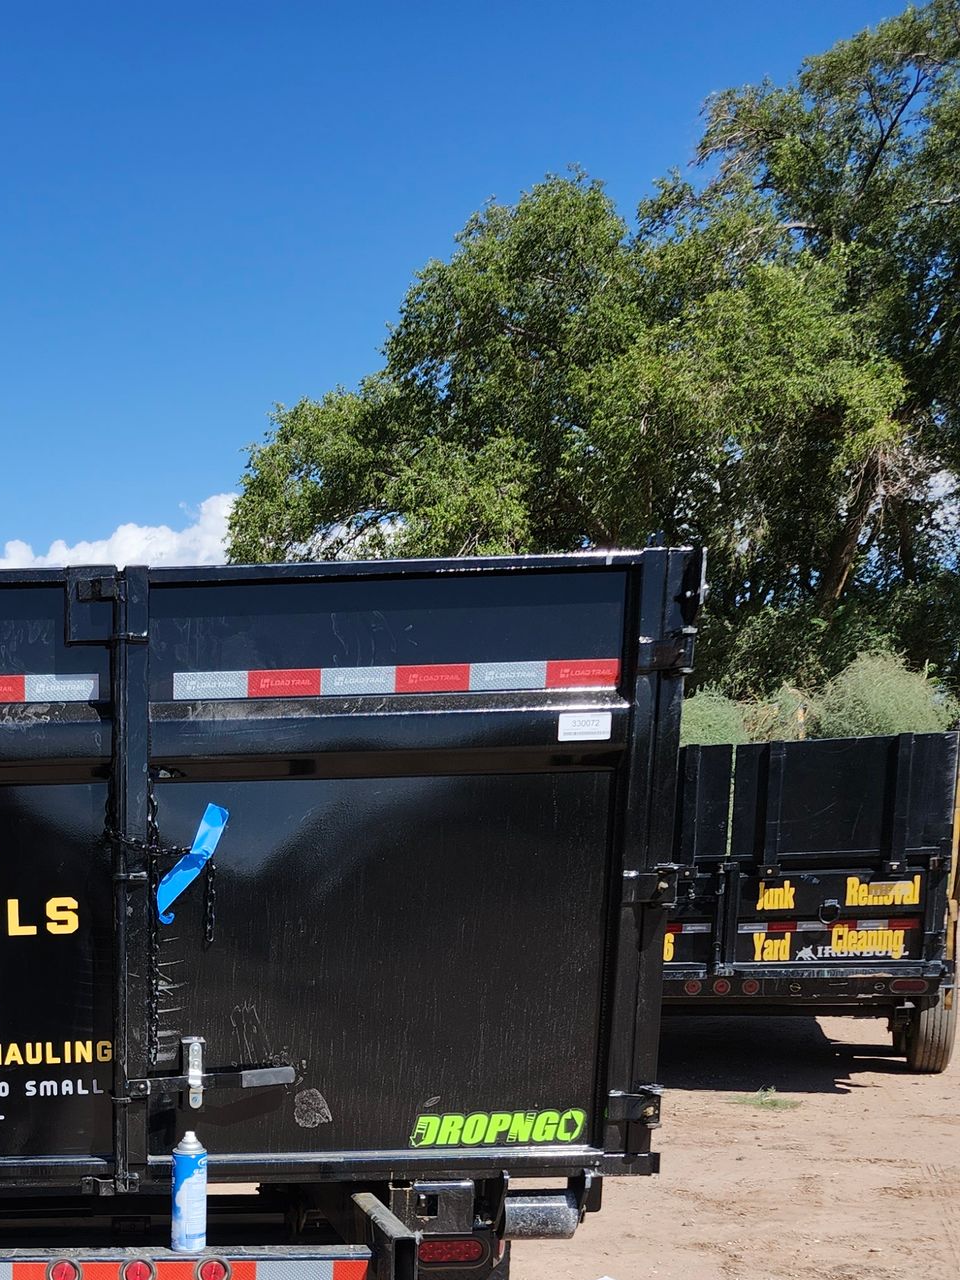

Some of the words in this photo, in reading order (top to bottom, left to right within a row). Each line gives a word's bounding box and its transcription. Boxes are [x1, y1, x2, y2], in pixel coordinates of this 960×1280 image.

[439, 674, 461, 682] TRAIL
[755, 879, 796, 911] Junk
[752, 931, 792, 962] Yard
[830, 923, 905, 960] Cleaning
[25, 1078, 105, 1097] SMALL
[410, 1109, 587, 1147] DROPNGO
